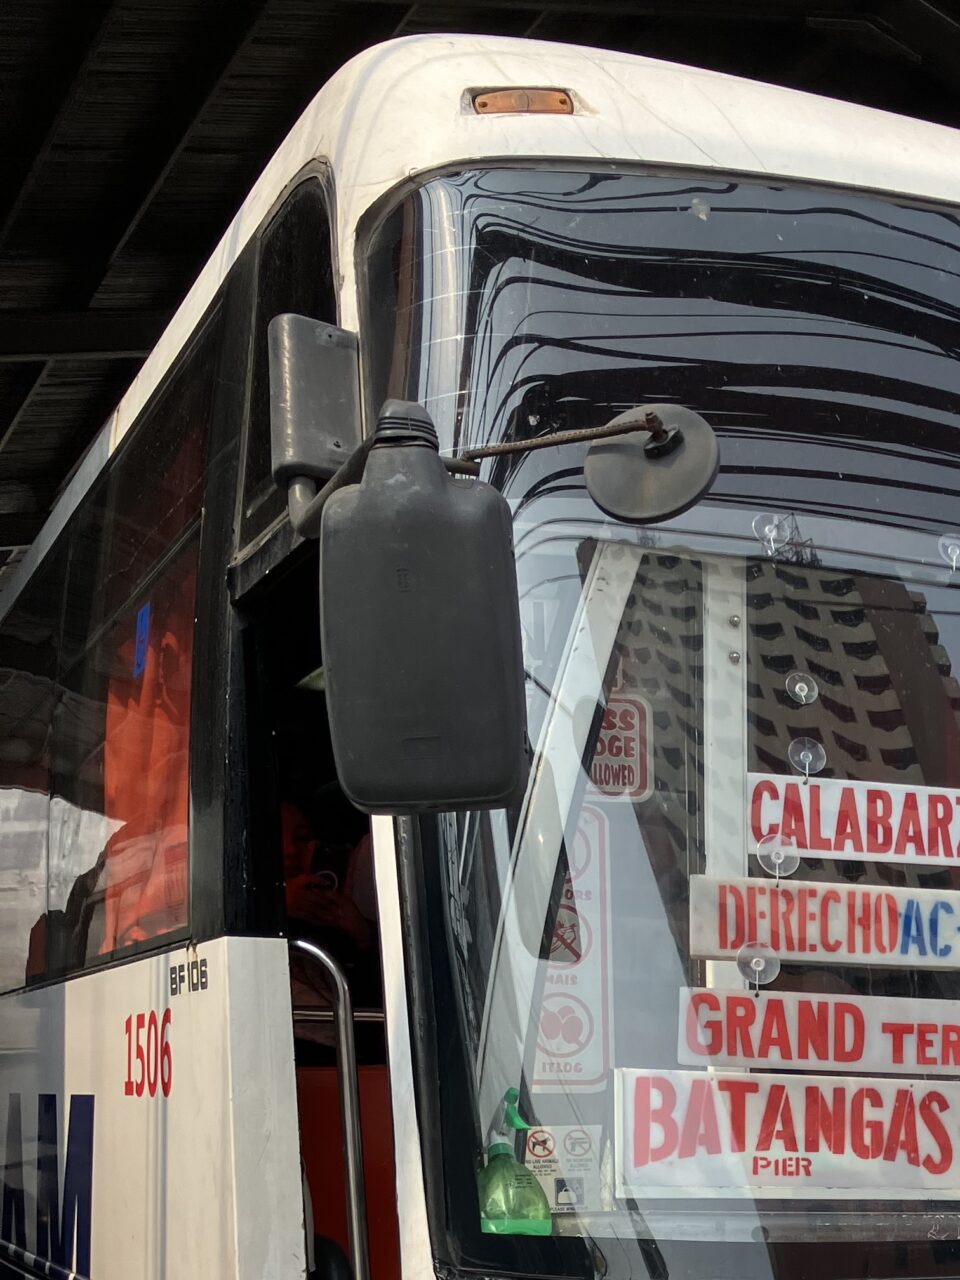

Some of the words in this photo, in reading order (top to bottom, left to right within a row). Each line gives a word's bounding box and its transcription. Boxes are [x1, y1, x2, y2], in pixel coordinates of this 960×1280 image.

[601, 707, 636, 731] SS
[595, 735, 636, 758] DGE
[591, 762, 635, 786] LLOWED
[718, 884, 899, 954] DERECHO
[685, 992, 866, 1063] GRAND
[124, 1007, 173, 1098] 1506
[634, 1076, 953, 1175] BATANGAS
[752, 1156, 812, 1177] PIER
